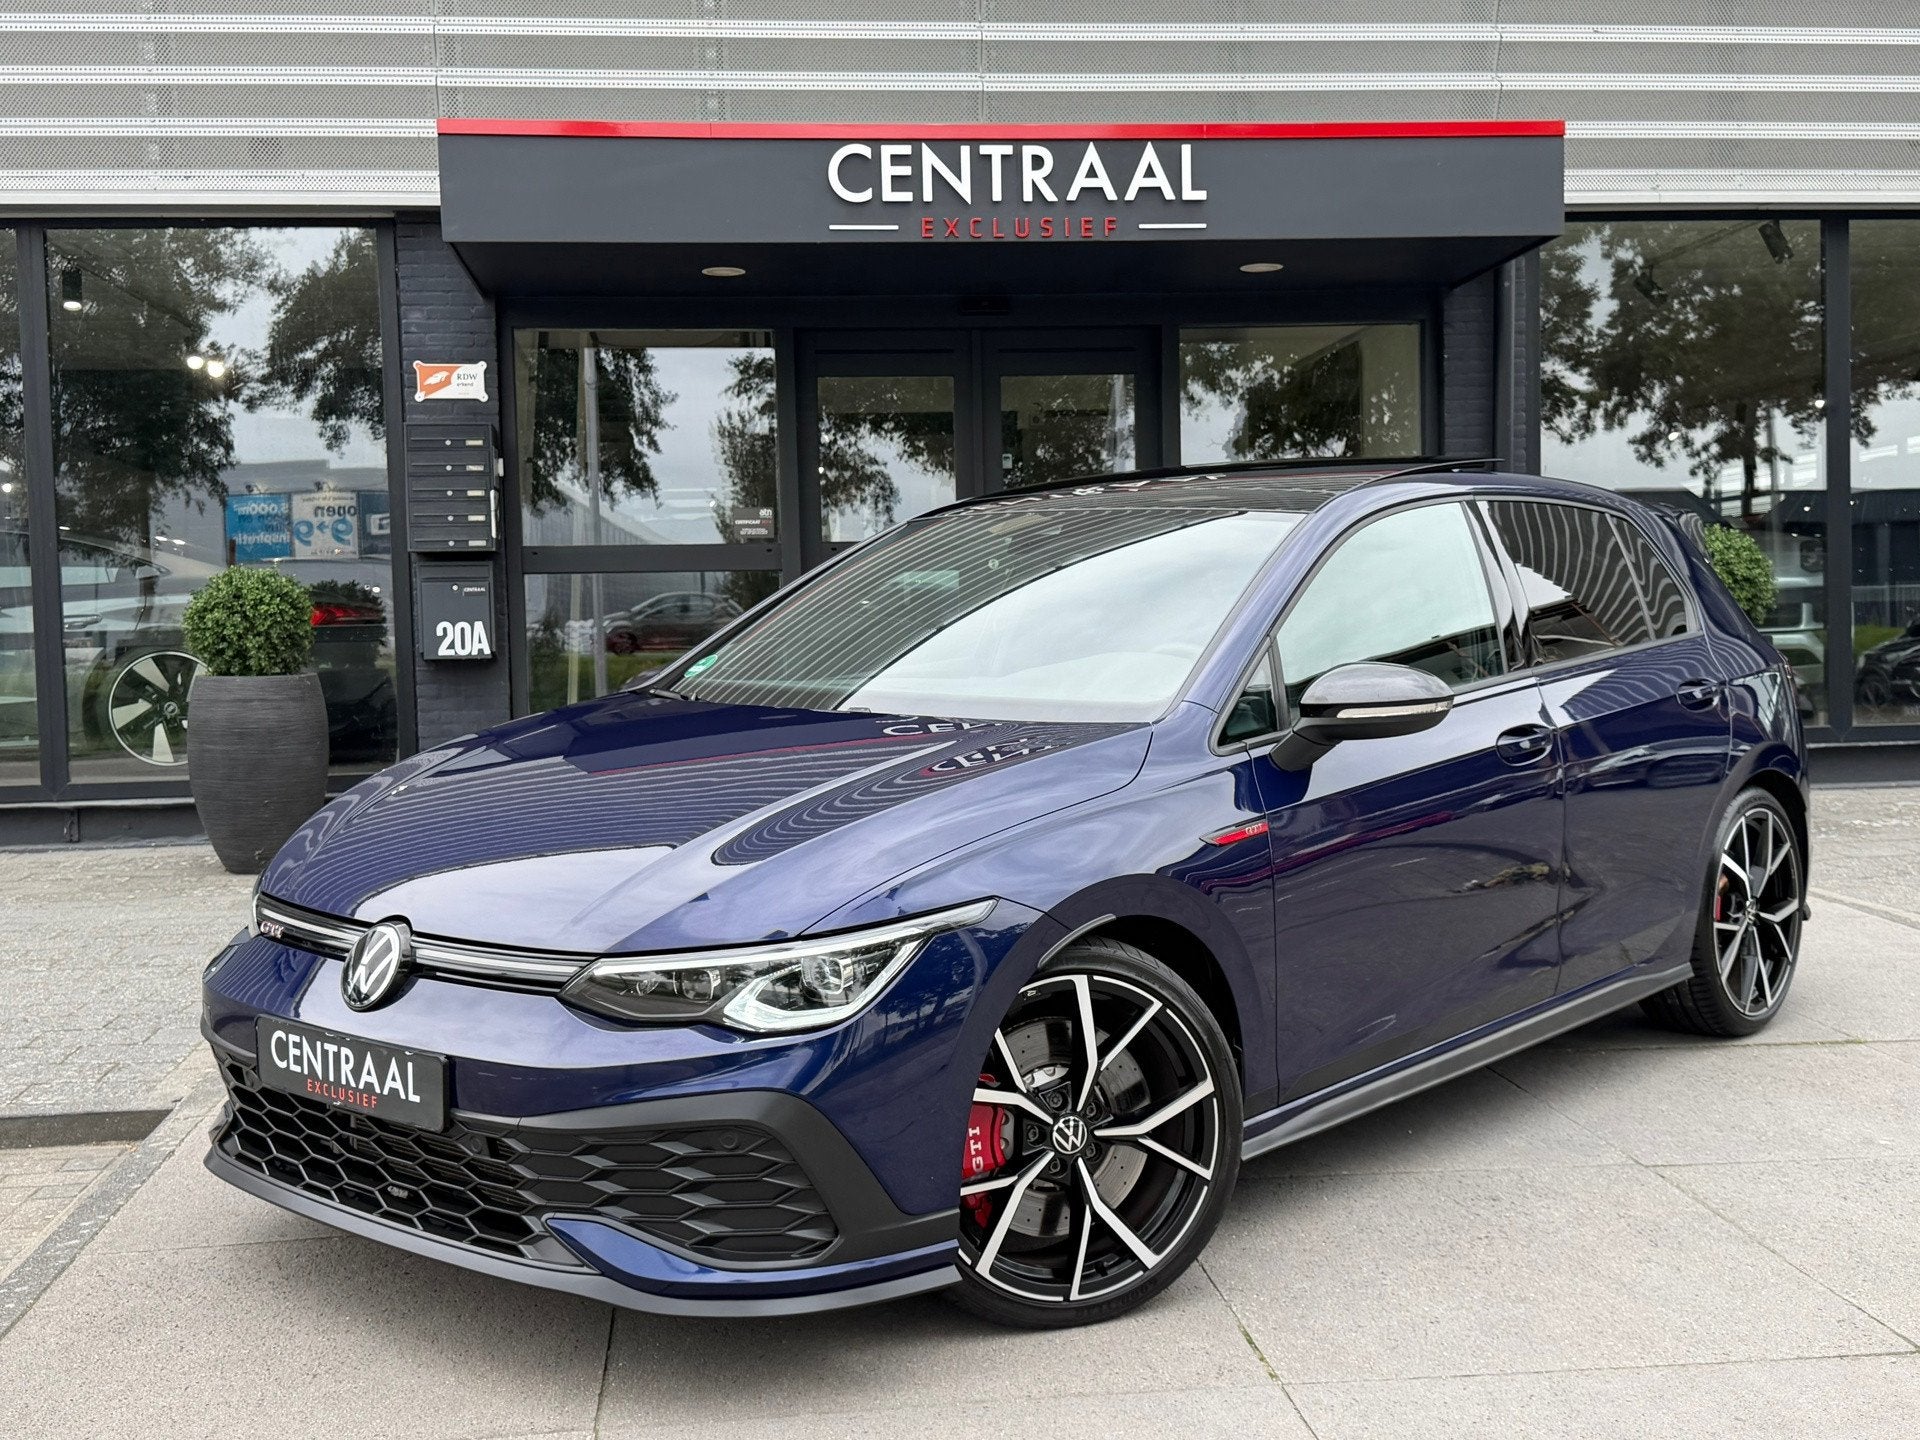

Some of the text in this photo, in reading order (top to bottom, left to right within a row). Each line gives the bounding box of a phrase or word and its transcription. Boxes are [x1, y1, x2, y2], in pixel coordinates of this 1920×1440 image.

[827, 141, 1208, 205] CENTRAAL
[921, 217, 1119, 238] EXCLUSIEF
[456, 373, 478, 381] RDW
[436, 621, 491, 656] 20A
[260, 921, 285, 939] GTI
[270, 1029, 421, 1103] CENTRAAL
[307, 1078, 378, 1109] EXCLUSIEF
[968, 1126, 984, 1173] GTI
